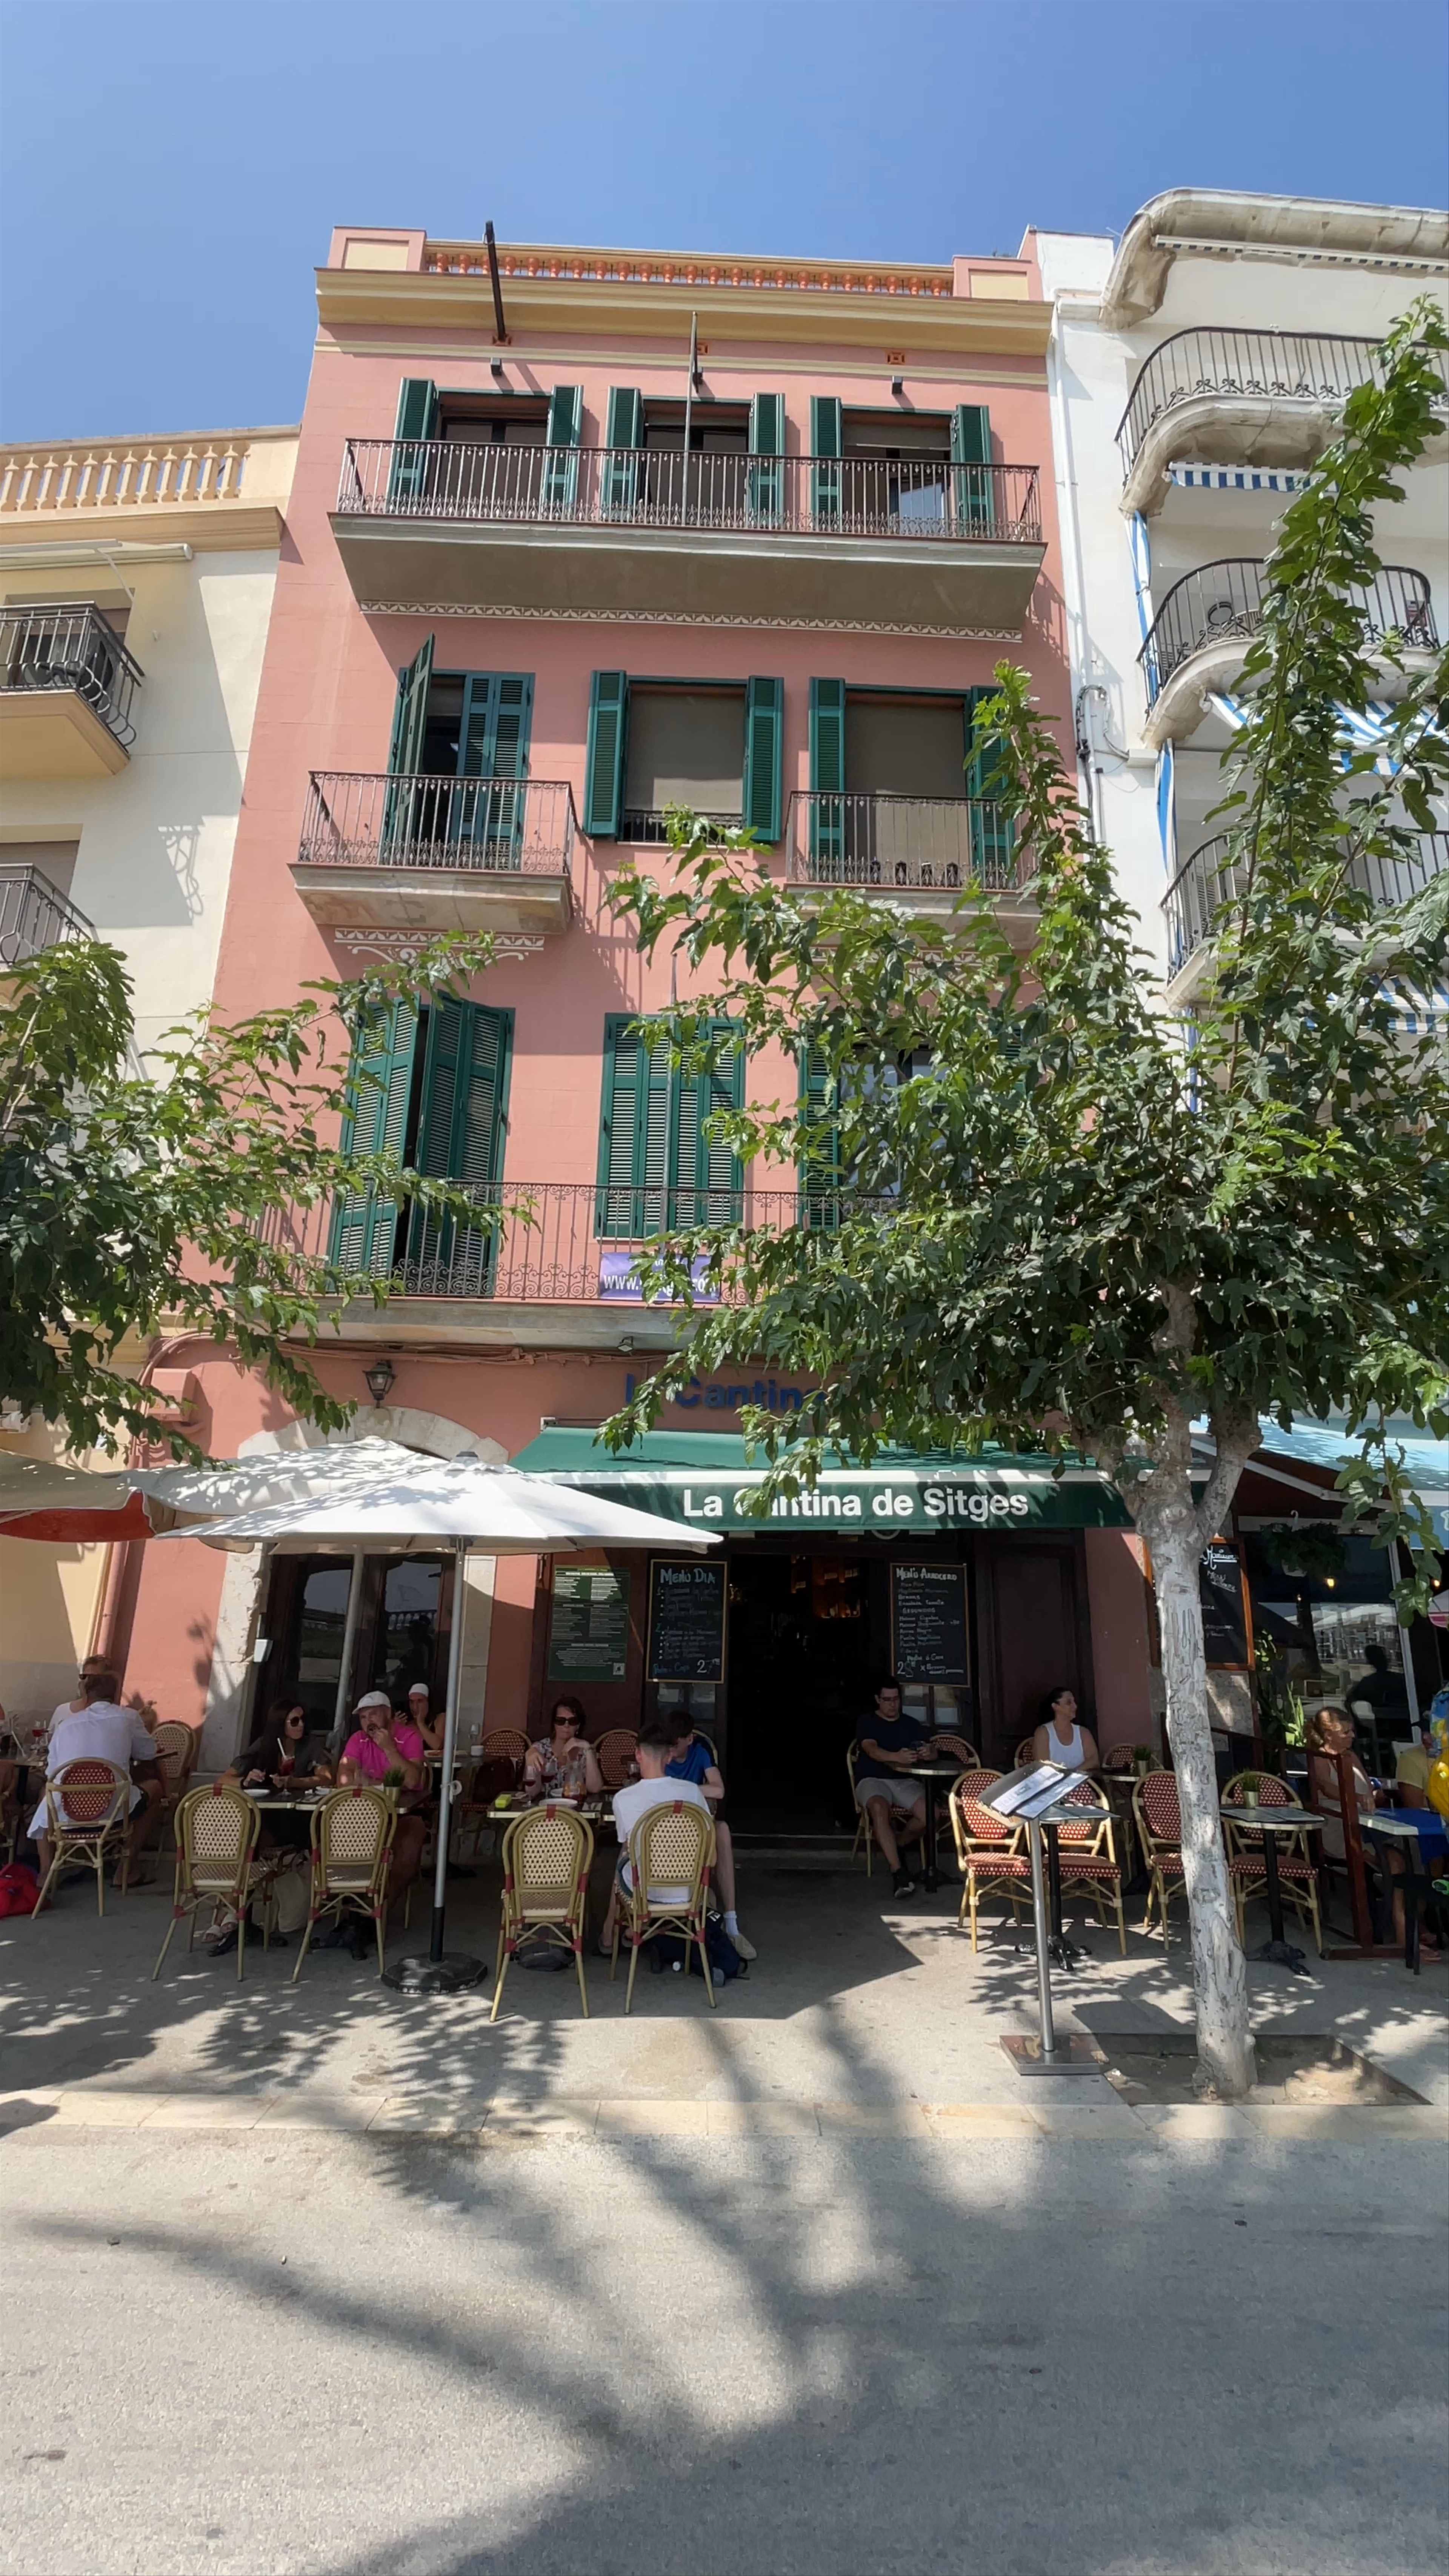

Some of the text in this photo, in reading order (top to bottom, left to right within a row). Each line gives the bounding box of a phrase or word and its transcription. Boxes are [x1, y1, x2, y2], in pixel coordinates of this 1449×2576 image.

[683, 1488, 1028, 1523] La ntina de Sitges
